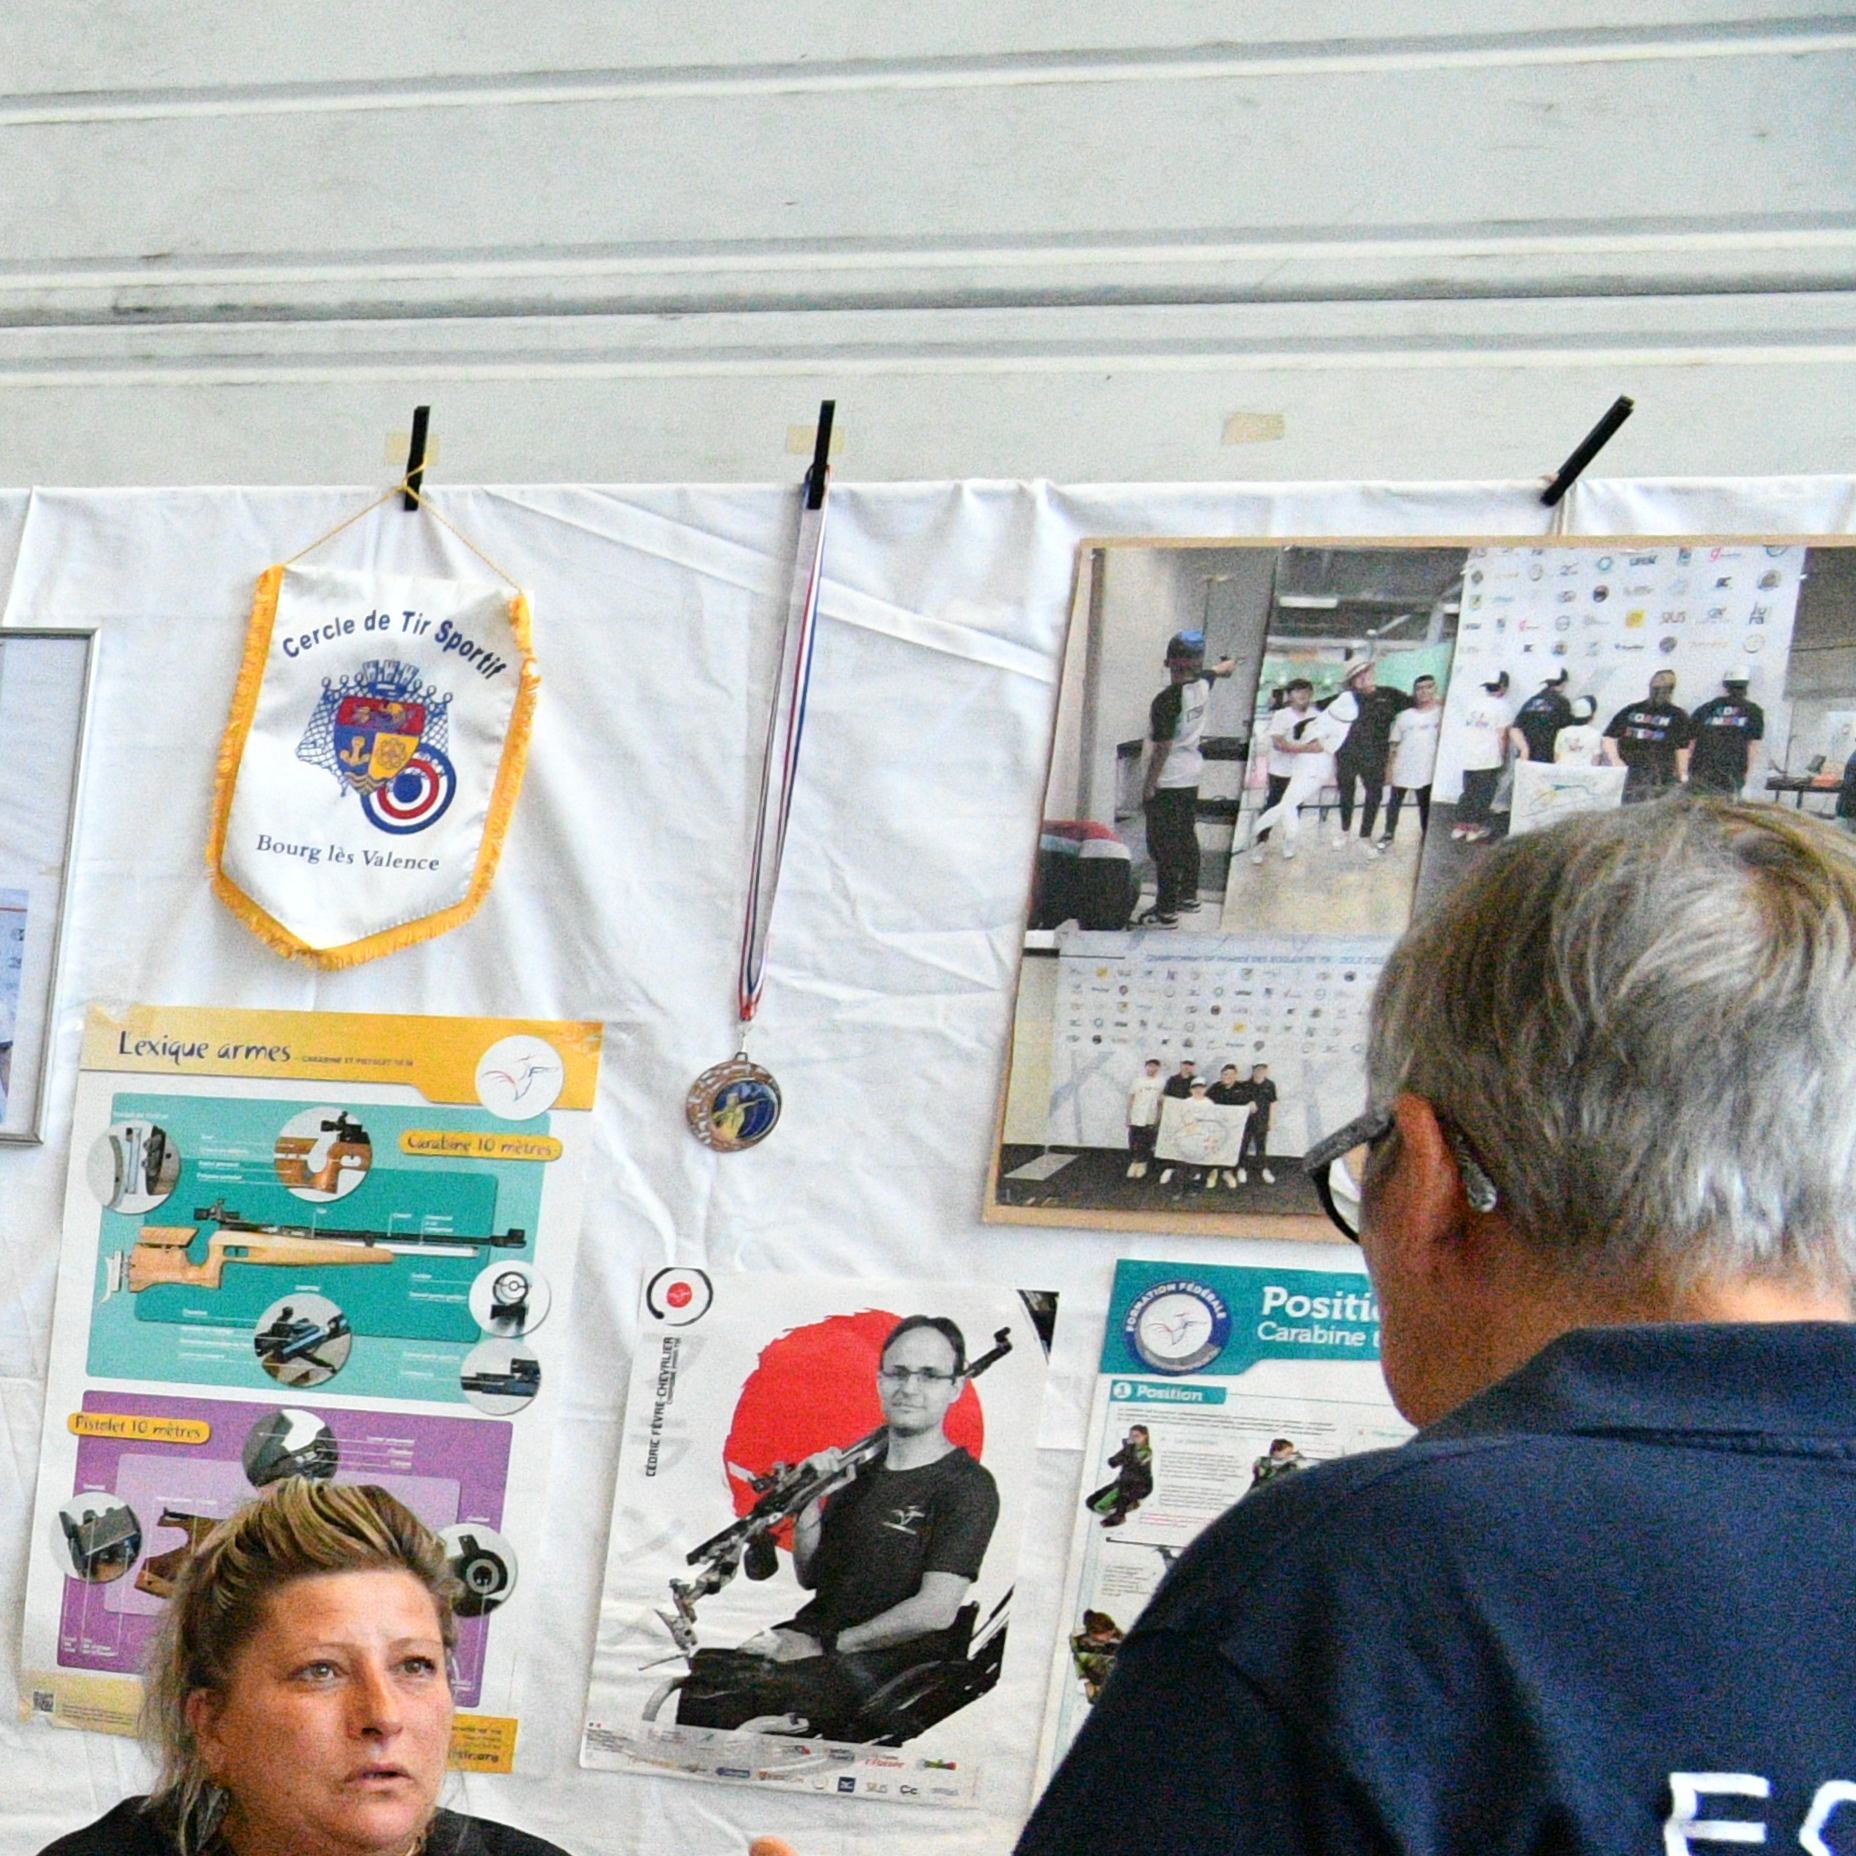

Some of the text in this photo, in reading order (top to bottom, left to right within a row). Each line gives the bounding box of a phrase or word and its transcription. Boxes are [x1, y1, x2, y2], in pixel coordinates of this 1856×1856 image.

[282, 609, 507, 680] Cercle de Tir Sportif
[256, 834, 440, 871] Bourg lès Valence
[119, 1030, 292, 1065] Lexique armes
[407, 1134, 555, 1155] Carabine 10 mètres
[1126, 1283, 1176, 1332] FORMATION
[1257, 1322, 1366, 1347] Carabine
[1137, 1384, 1203, 1402] Position
[75, 1416, 201, 1438] Pistolet 10 mètres
